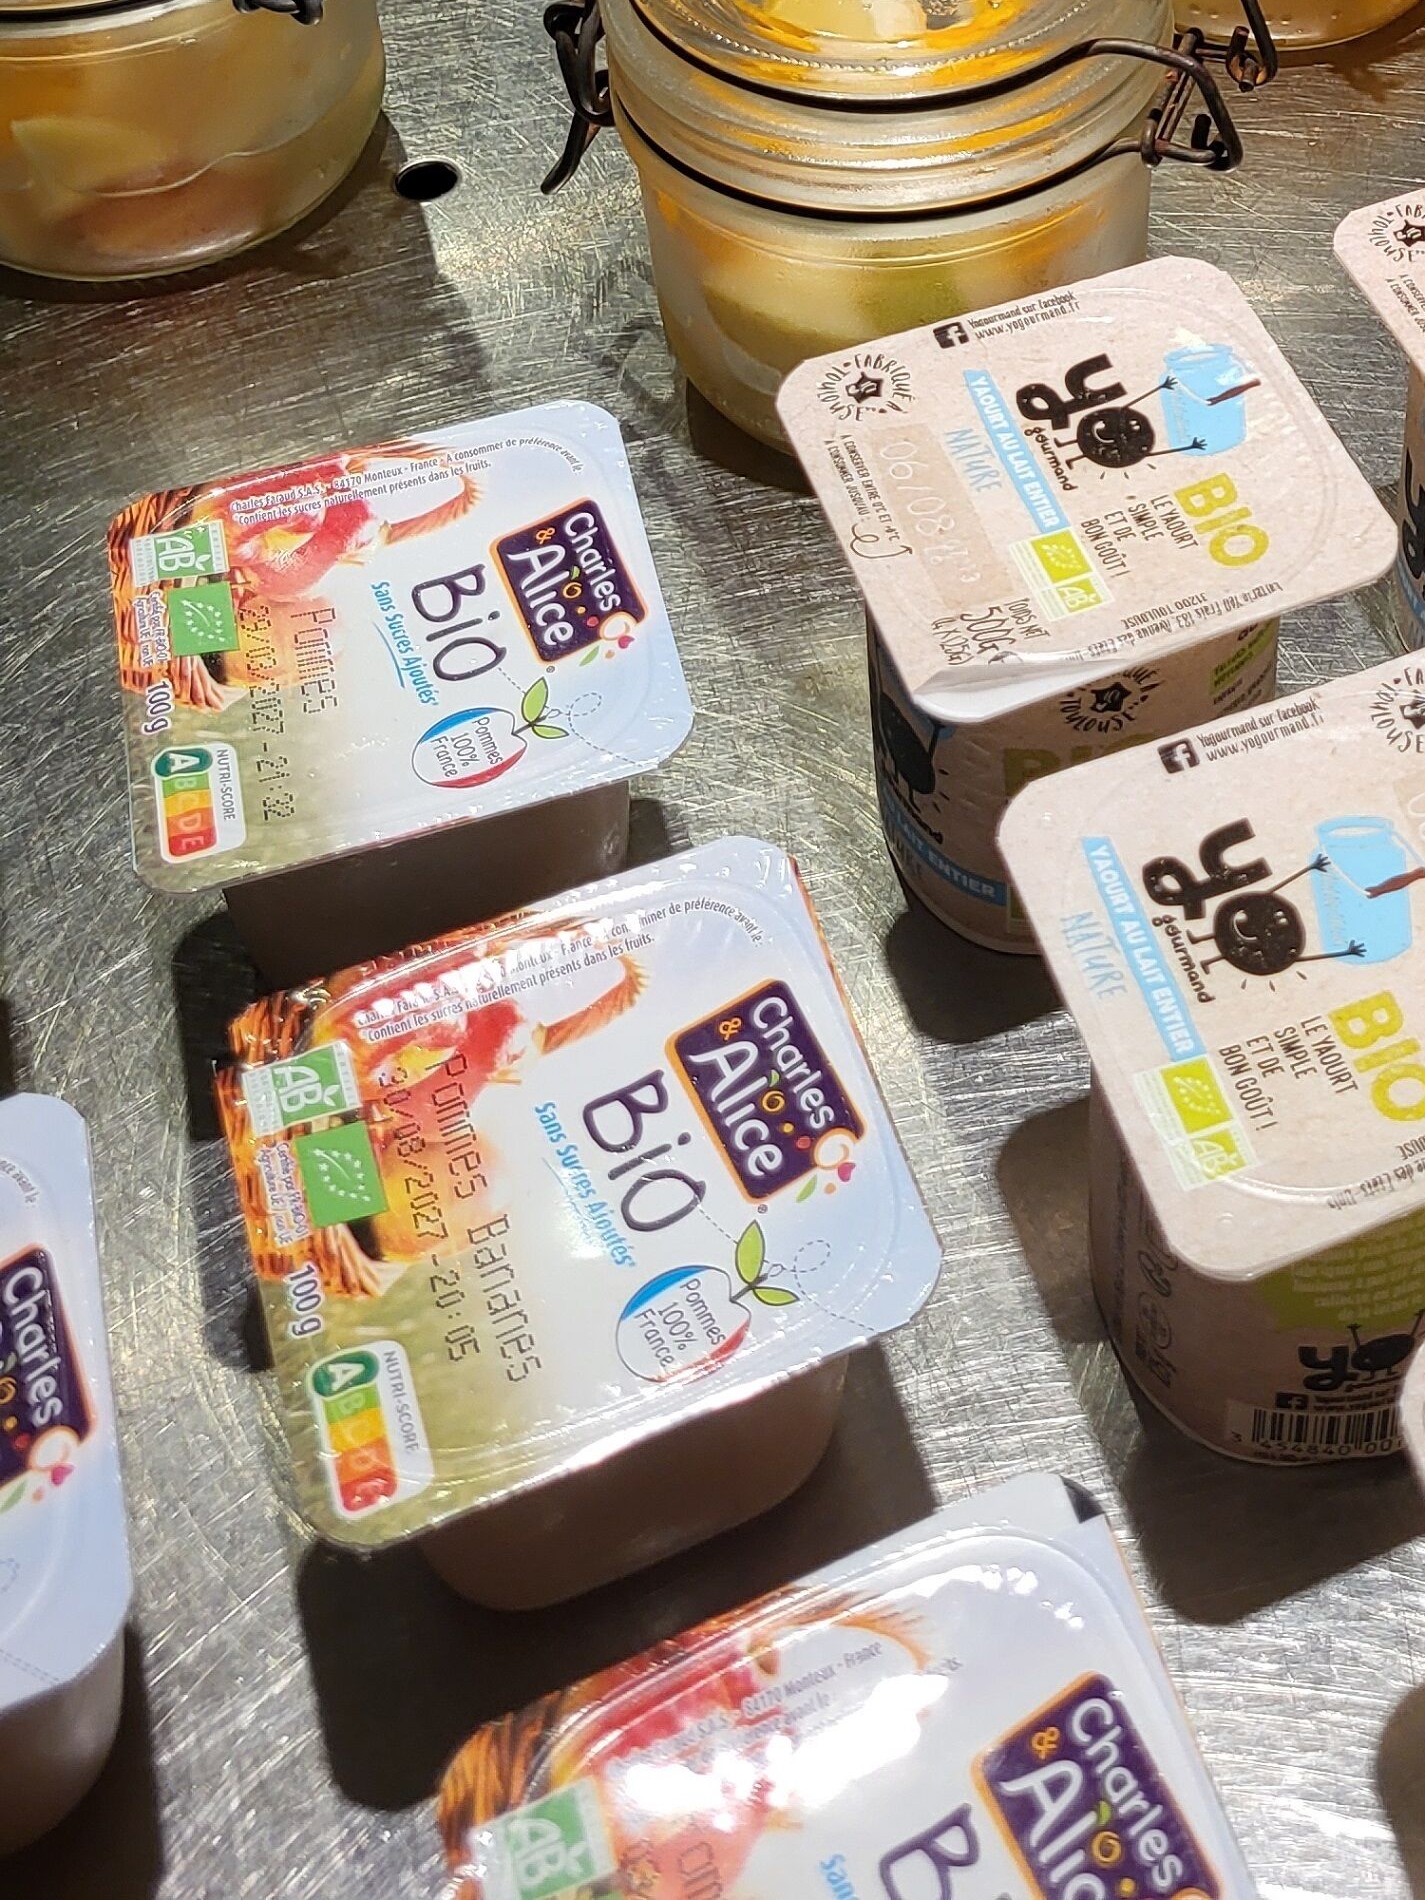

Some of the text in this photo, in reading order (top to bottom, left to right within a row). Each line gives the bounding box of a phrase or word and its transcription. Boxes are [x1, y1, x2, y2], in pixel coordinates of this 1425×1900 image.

[453, 441, 503, 461] consommer
[968, 377, 1062, 528] YAOURT AU LAIT ENTIER
[1023, 424, 1078, 492] gourmand
[292, 499, 322, 514] sucres
[387, 475, 427, 492] présents
[427, 469, 450, 483] dans
[1171, 472, 1267, 566] BIO
[370, 580, 399, 613] Sans
[505, 526, 576, 645] & Alice
[562, 510, 621, 612] Charles
[289, 606, 340, 716] Pommes
[384, 611, 415, 655] Sucres
[430, 734, 460, 779] France
[450, 730, 479, 767] 100%
[471, 715, 505, 765] Pommes
[213, 747, 237, 822] NUTRI-SCORE
[1088, 845, 1196, 1055] YAOURT AU LAIT ENTIER
[1151, 911, 1216, 1006] gourmand
[747, 994, 832, 1131] Charles
[1217, 1042, 1252, 1079] BON
[1245, 1033, 1284, 1079] ET DE
[1272, 1023, 1317, 1080] SIMPLE
[1299, 1014, 1358, 1098] LE YAOURT
[533, 1100, 572, 1147] Sans
[688, 1016, 784, 1176] & Alice
[422, 1053, 544, 1386] Pommes Bananes
[5, 1266, 64, 1429] Charles
[634, 1306, 676, 1369] France
[658, 1299, 698, 1352] 100%
[679, 1275, 727, 1348] Pommes
[381, 1348, 419, 1455] NUTRI-SCORE
[999, 1726, 1107, 1900] & Alic
[1071, 1698, 1184, 1893] Charles
